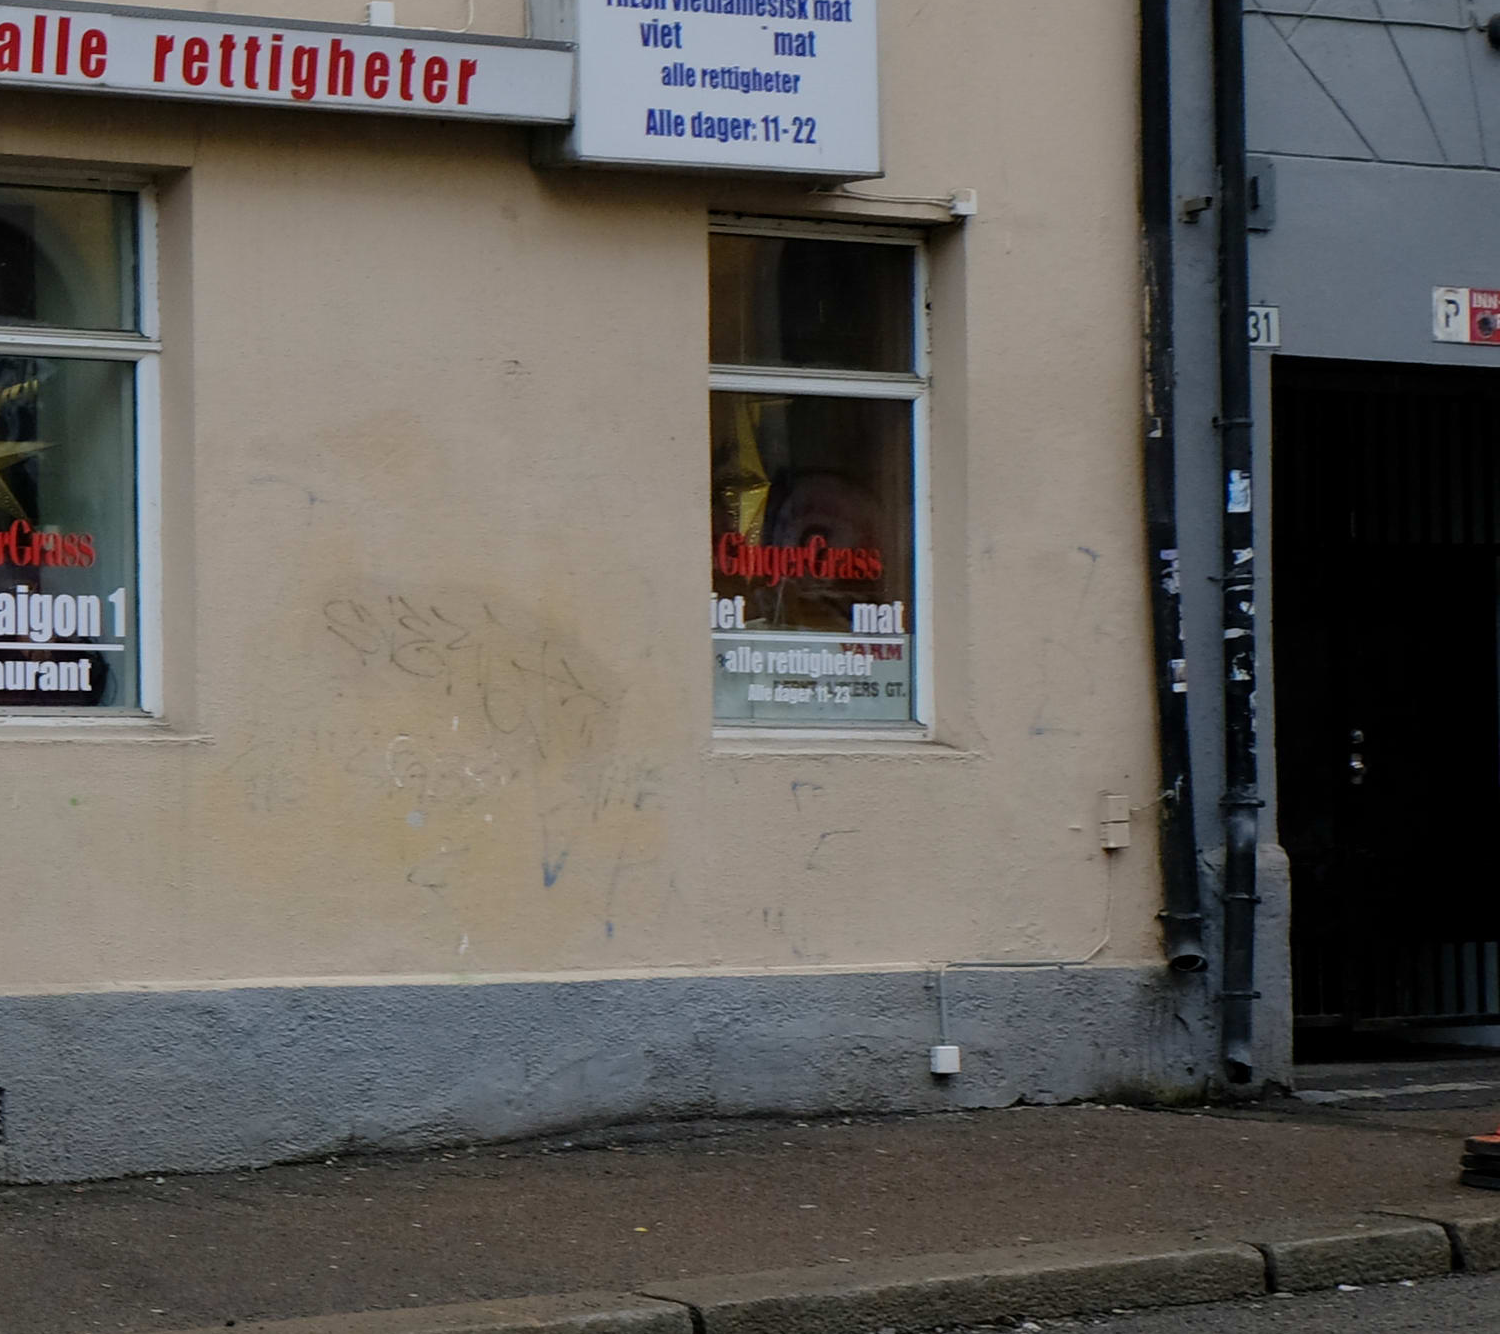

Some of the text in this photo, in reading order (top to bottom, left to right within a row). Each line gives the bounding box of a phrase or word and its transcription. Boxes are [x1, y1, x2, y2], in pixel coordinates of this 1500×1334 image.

[640, 18, 817, 57] viet mat
[153, 34, 479, 105] rettigheter
[661, 63, 802, 95] alle rettigheter
[646, 108, 685, 138] Alle
[691, 112, 757, 144] dager:
[1247, 310, 1272, 344] 31
[718, 531, 884, 587] GingerGrass
[108, 587, 127, 638] 1
[710, 592, 906, 634] iet mat
[724, 647, 875, 679] alle rettigheter
[748, 684, 773, 701] Alle
